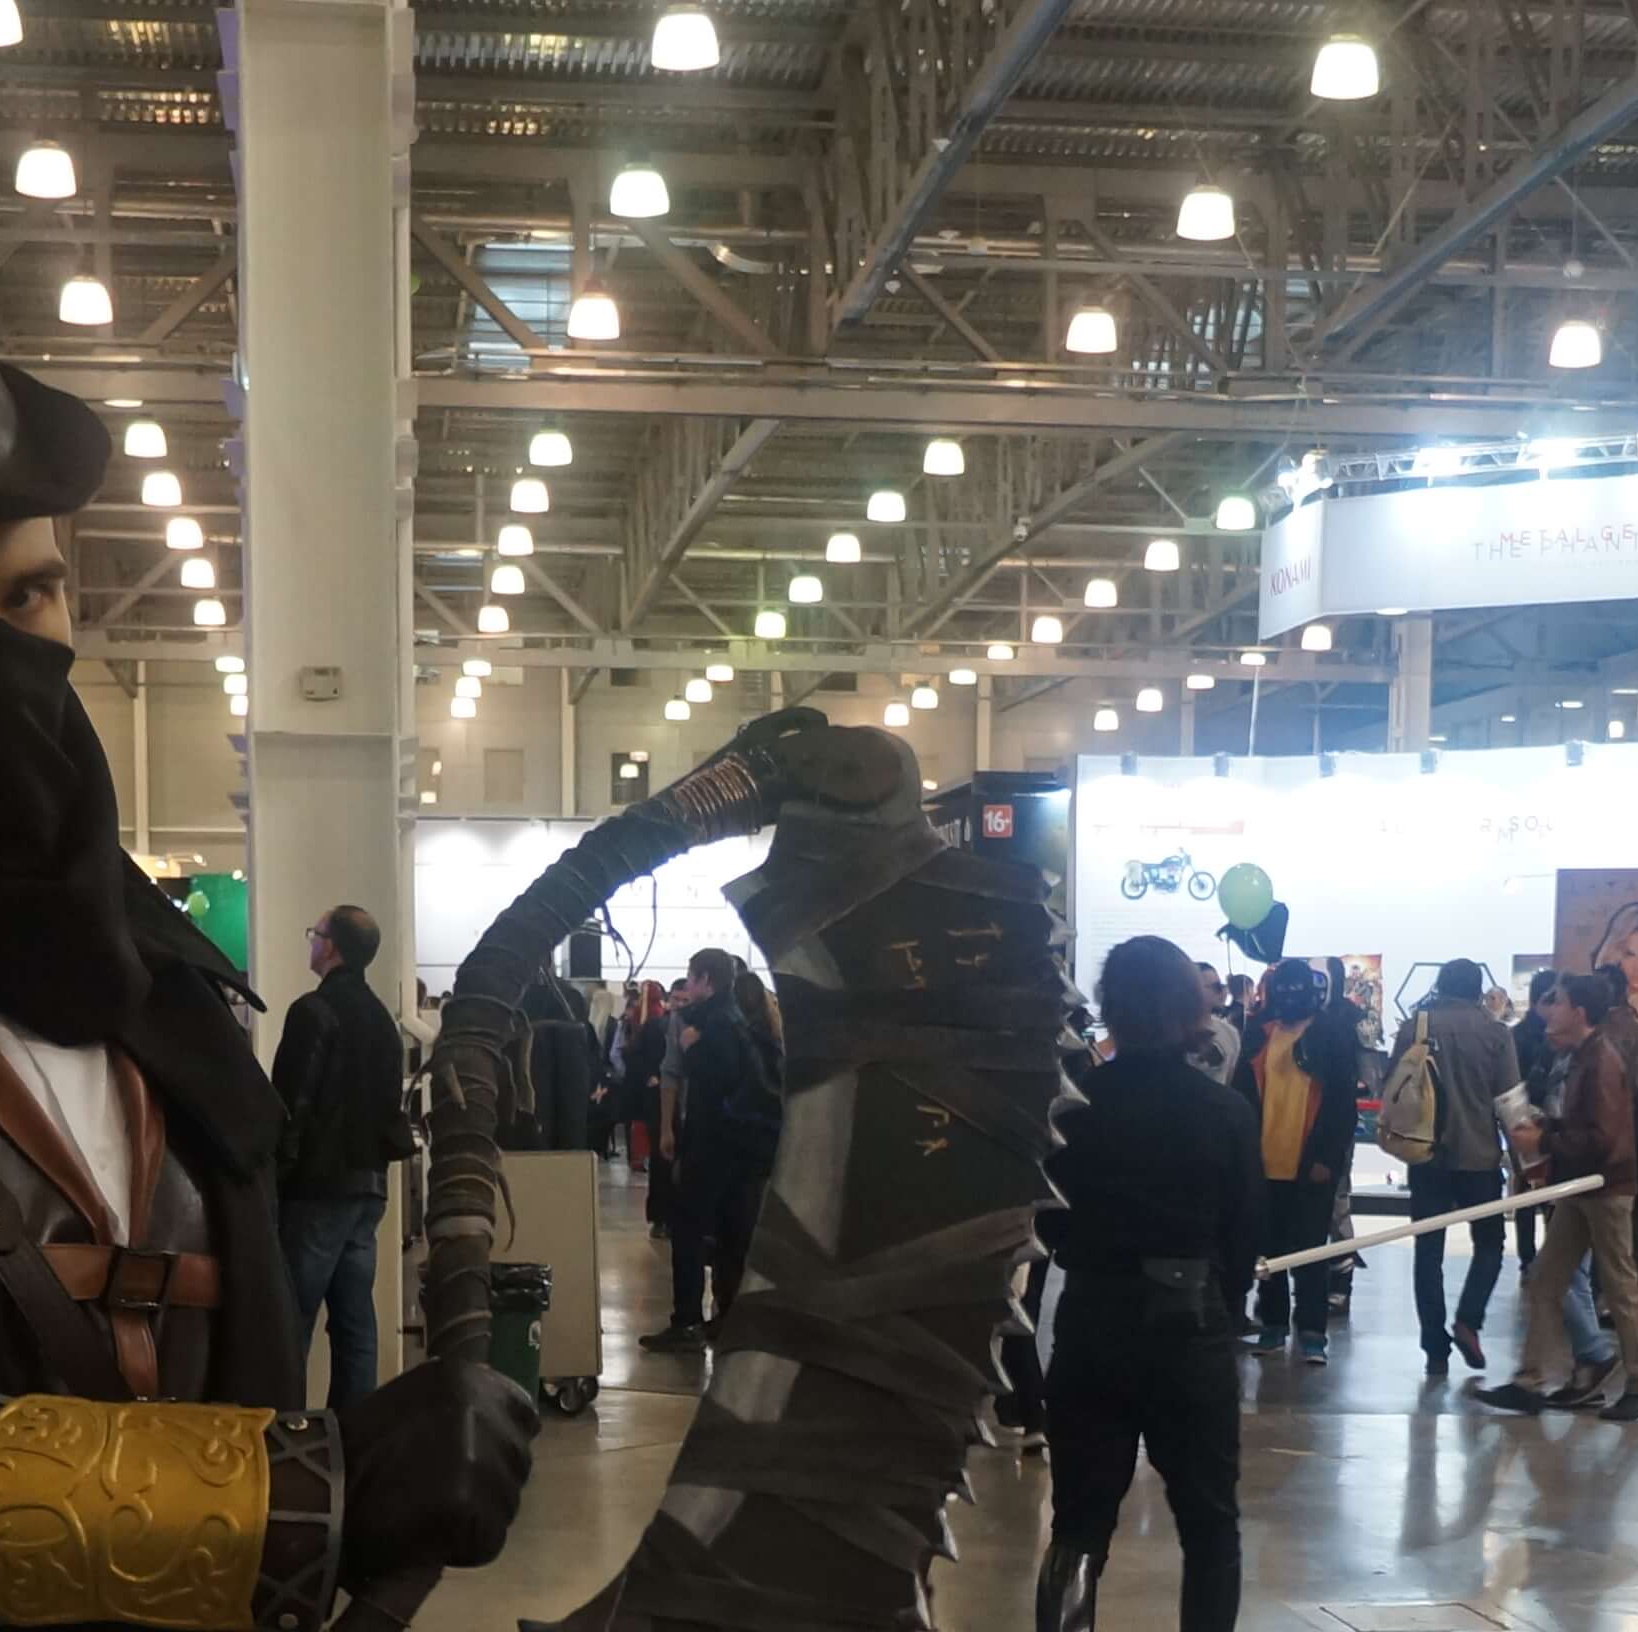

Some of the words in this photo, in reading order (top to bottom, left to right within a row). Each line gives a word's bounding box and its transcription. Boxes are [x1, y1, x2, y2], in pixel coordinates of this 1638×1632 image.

[1499, 527, 1586, 547] METAL
[1267, 554, 1312, 600] KONAMI
[985, 811, 1011, 833] 16+
